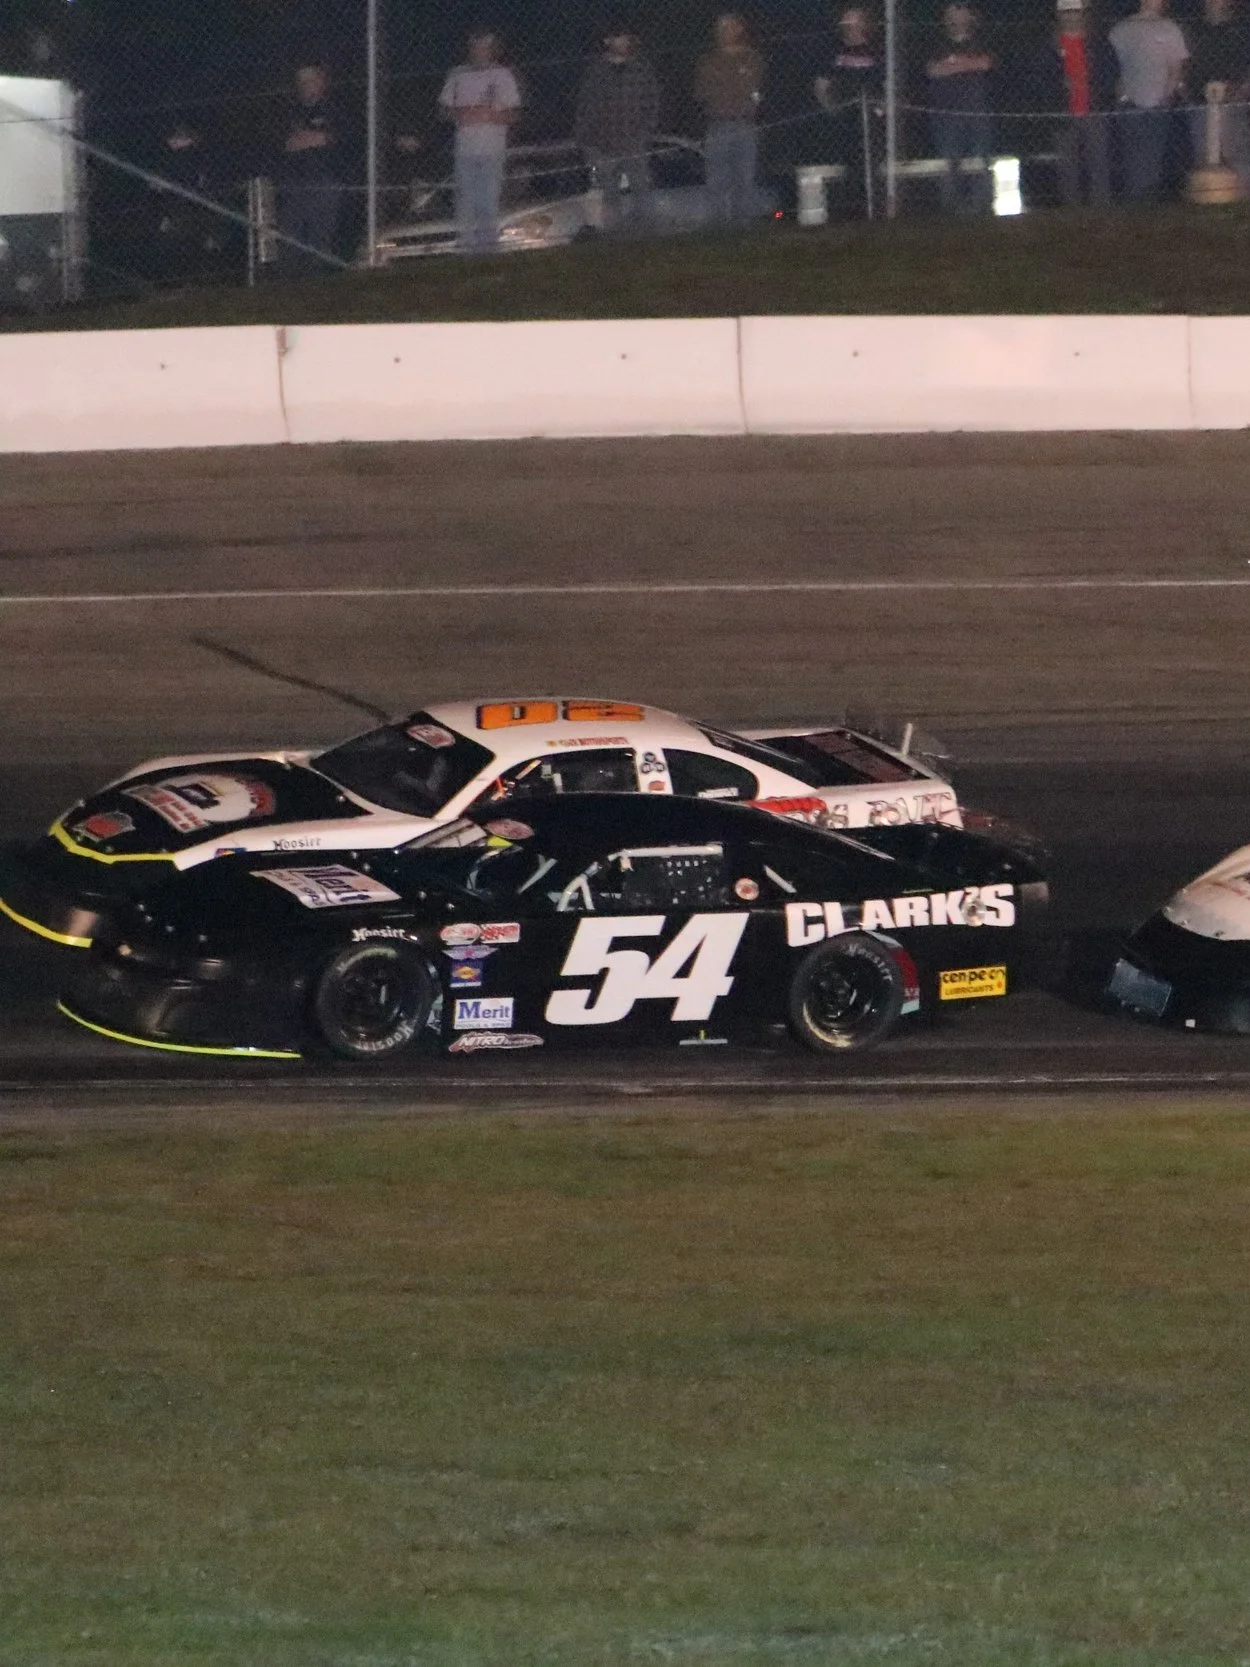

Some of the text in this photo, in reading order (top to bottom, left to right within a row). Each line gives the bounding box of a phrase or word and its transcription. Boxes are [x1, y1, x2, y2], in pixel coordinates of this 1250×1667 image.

[272, 836, 322, 851] Hoosier
[784, 883, 1016, 947] CLARK'S
[352, 925, 406, 942] Hoosier
[545, 911, 750, 1026] 54
[458, 1001, 510, 1019] Merit
[460, 1035, 506, 1047] NITRO
